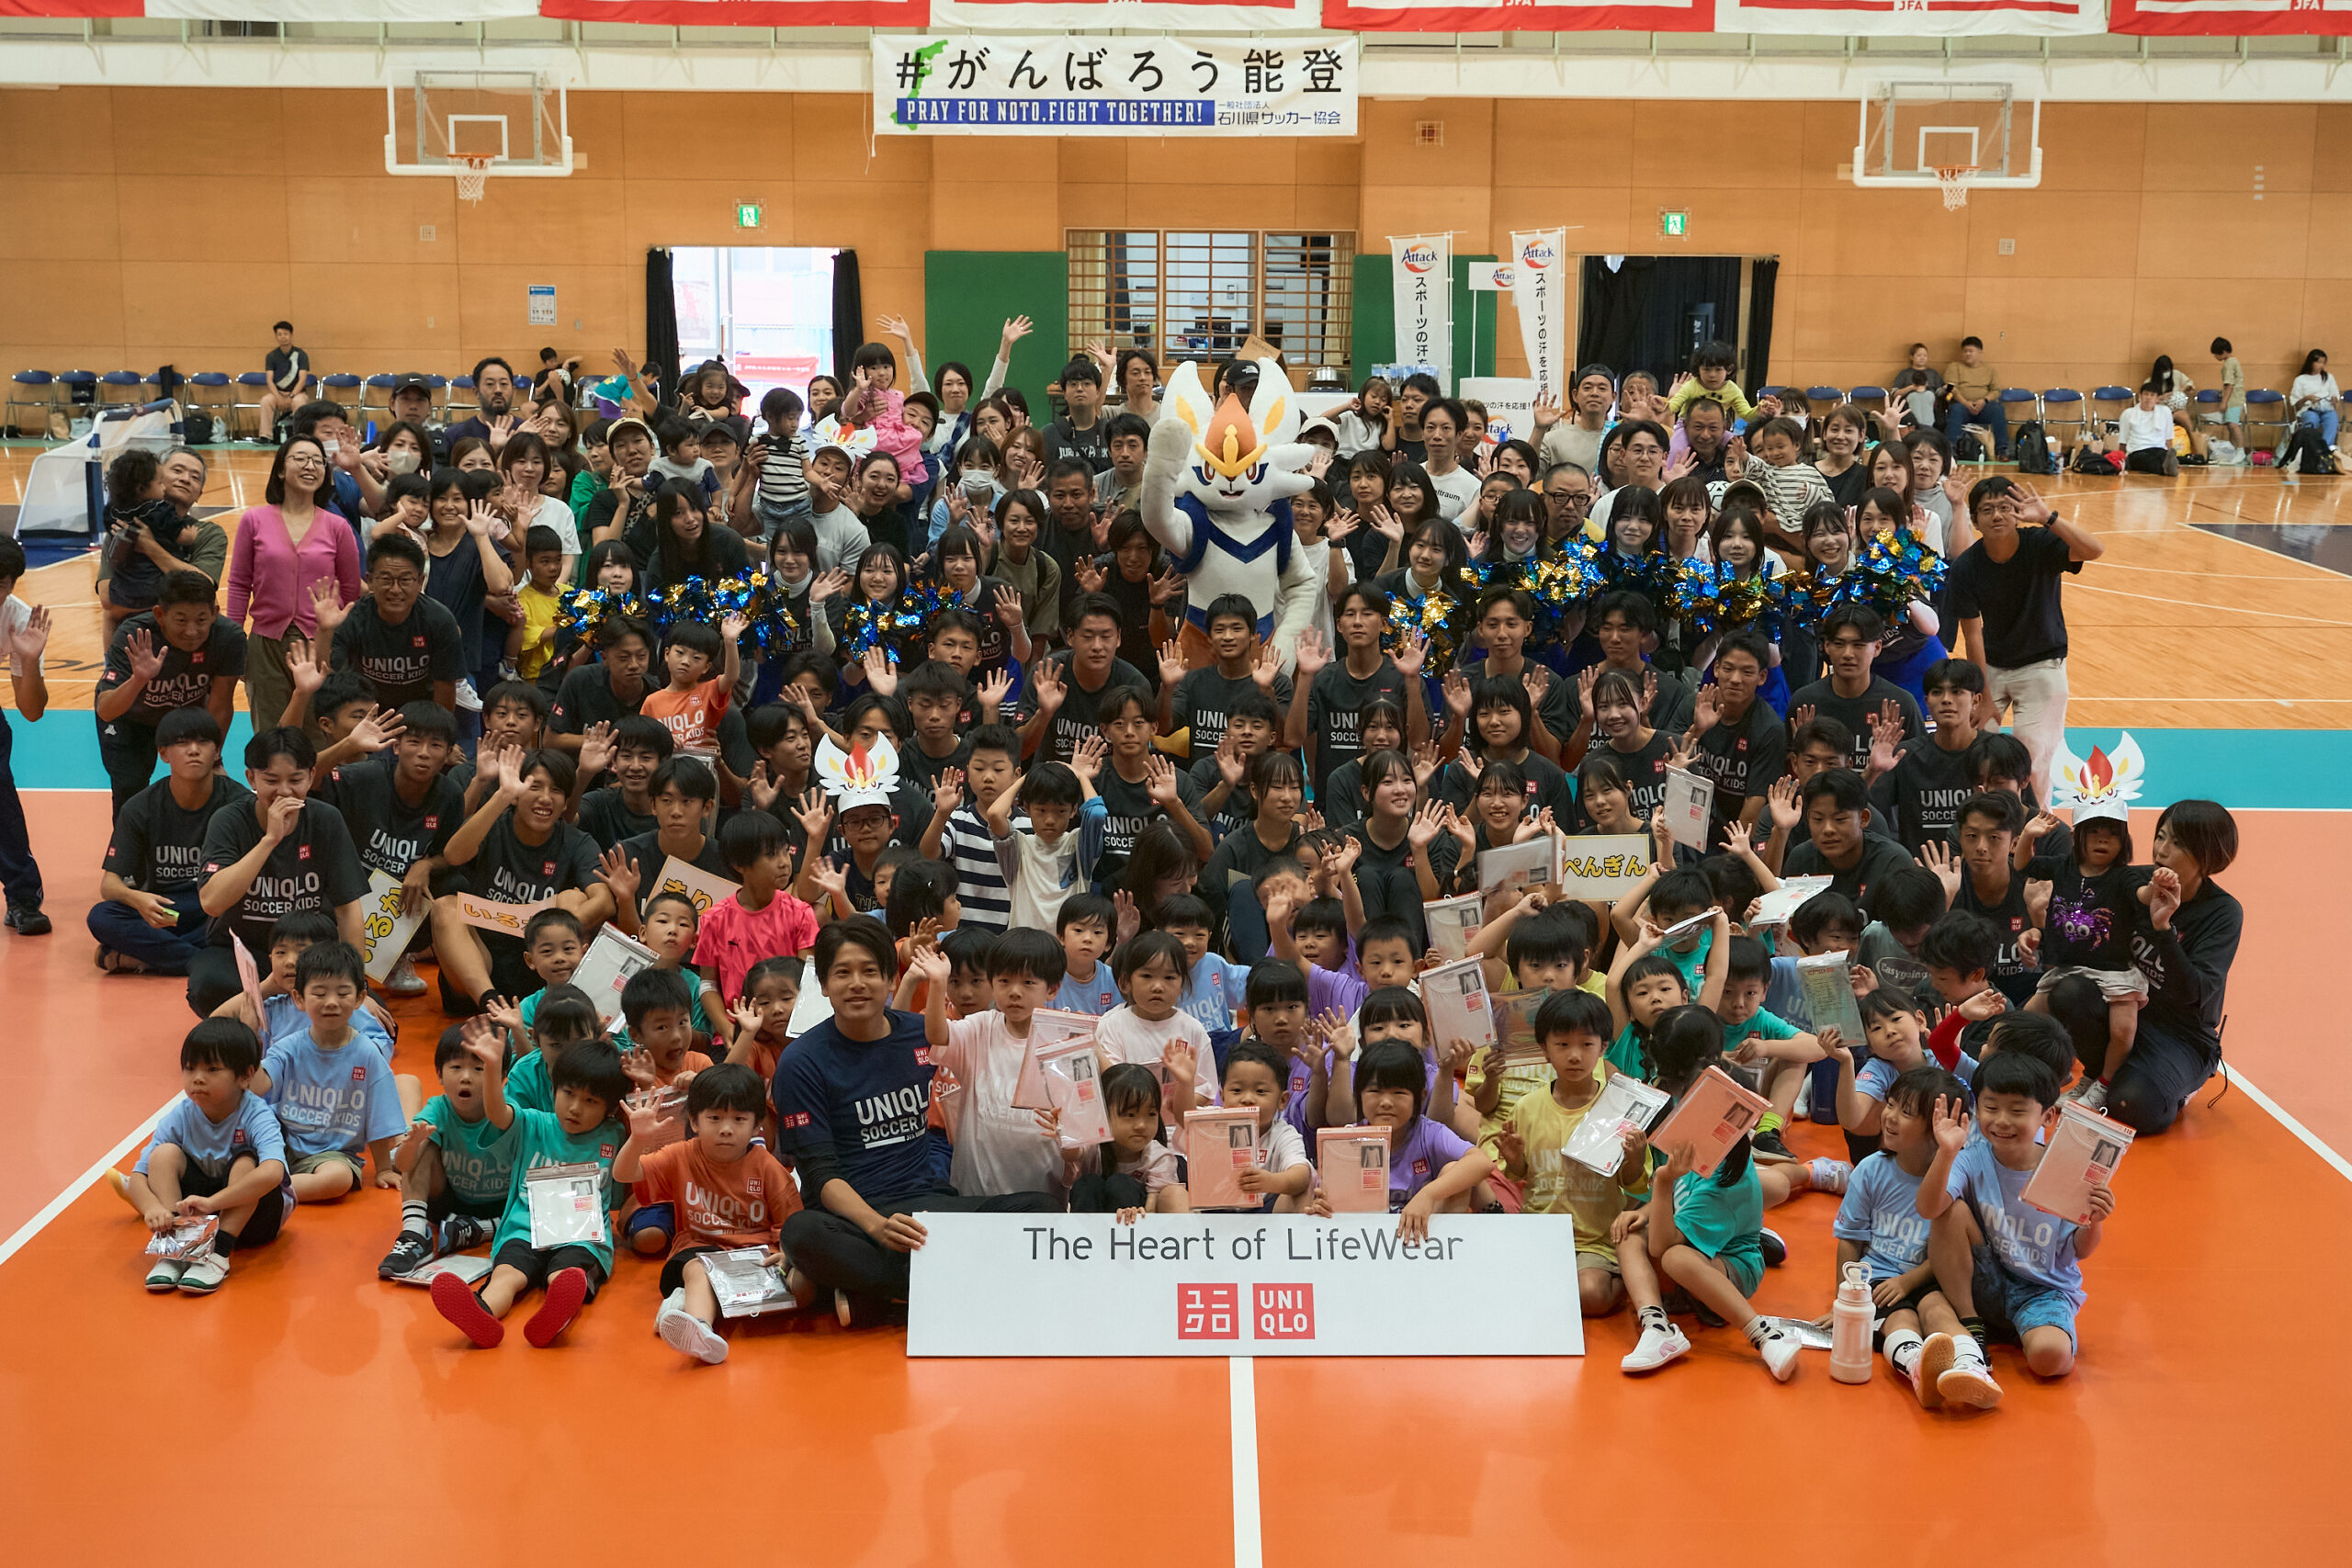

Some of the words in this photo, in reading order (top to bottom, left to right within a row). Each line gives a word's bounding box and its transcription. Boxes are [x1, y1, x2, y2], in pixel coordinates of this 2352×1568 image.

[1898, 1, 1923, 11] JFA
[907, 100, 949, 121] PRAY
[958, 101, 989, 121] FOR
[1107, 102, 1203, 123] TOGETHER!
[1217, 100, 1270, 109] 一般社団法人
[1217, 111, 1341, 126] 石川県サッカー協会
[1401, 248, 1438, 264] Attack
[1521, 244, 1554, 260] Attack
[1492, 269, 1515, 281] Attac
[1488, 423, 1513, 434] ttack
[362, 654, 430, 673] UNIQLO
[146, 673, 209, 694] UNQLO
[658, 709, 705, 732] NIQLO
[1196, 709, 1229, 729] UNI
[1329, 712, 1360, 730] UNI
[686, 727, 705, 740] KIDS
[1195, 729, 1226, 742] SOCCE
[1330, 731, 1361, 742] SOCCE
[1724, 777, 1746, 791] KIDS
[1921, 810, 1957, 820] SOCCE
[370, 829, 428, 863] UNIQL
[1104, 836, 1136, 848] SOCCE
[156, 845, 203, 865] UNIQ
[363, 848, 405, 874] SOCCER
[156, 866, 199, 878] SOCCER
[247, 871, 320, 901] UNIQLO
[493, 866, 555, 904] UNQLO
[243, 899, 292, 914] SOCCER
[294, 896, 322, 910] KIDS
[463, 902, 530, 930] いる
[1997, 963, 2023, 976] KIDS
[915, 1048, 926, 1056] UNI
[288, 1079, 365, 1112] UNIQLO
[281, 1103, 332, 1124] SOCCER
[334, 1112, 362, 1127] KIDS
[860, 1116, 920, 1143] SOCCER
[1415, 1166, 1427, 1174] QLO
[685, 1181, 765, 1224] UNIQLO
[687, 1209, 734, 1228] SOCCE
[1023, 1227, 1092, 1260] The
[1110, 1227, 1215, 1260] Heart
[1231, 1227, 1266, 1260] of
[1287, 1227, 1464, 1261] LifeWear
[1185, 1290, 1230, 1308] ユニ
[1260, 1290, 1303, 1310] UNI
[1184, 1314, 1231, 1333] クロ
[1261, 1313, 1308, 1336] QLO
